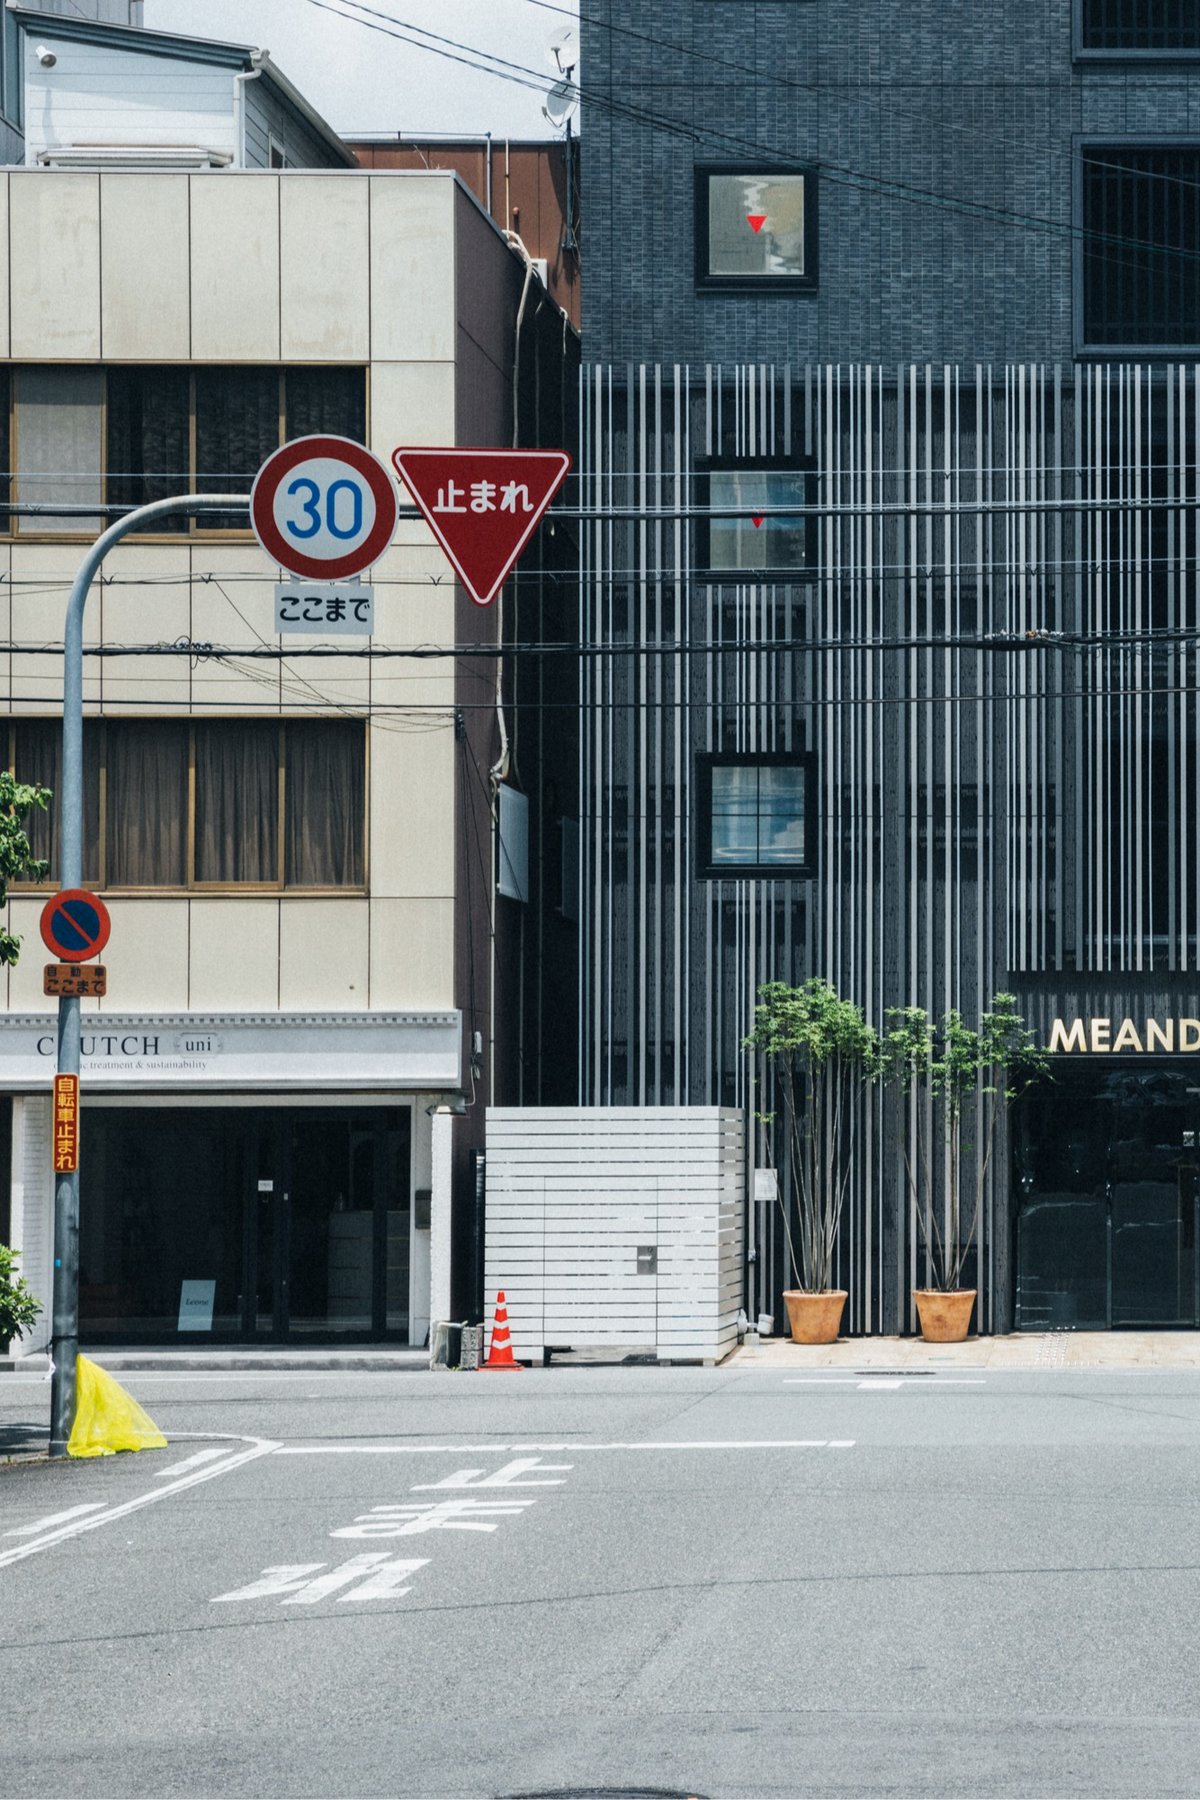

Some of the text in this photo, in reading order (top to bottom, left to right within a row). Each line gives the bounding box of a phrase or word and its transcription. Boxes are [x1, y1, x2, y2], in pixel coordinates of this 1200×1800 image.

[285, 477, 363, 540] 30
[431, 479, 535, 515] 止まれ
[278, 596, 371, 623] ここまで
[47, 966, 104, 976] 自動車
[47, 979, 104, 994] ここまで
[36, 1036, 212, 1056] CUTCH uni
[90, 1061, 133, 1070] treatment
[136, 1061, 143, 1069] &
[146, 1060, 207, 1071] sustainability
[57, 1077, 75, 1169] 自転車止まれ
[211, 1457, 576, 1605] 止まれ
